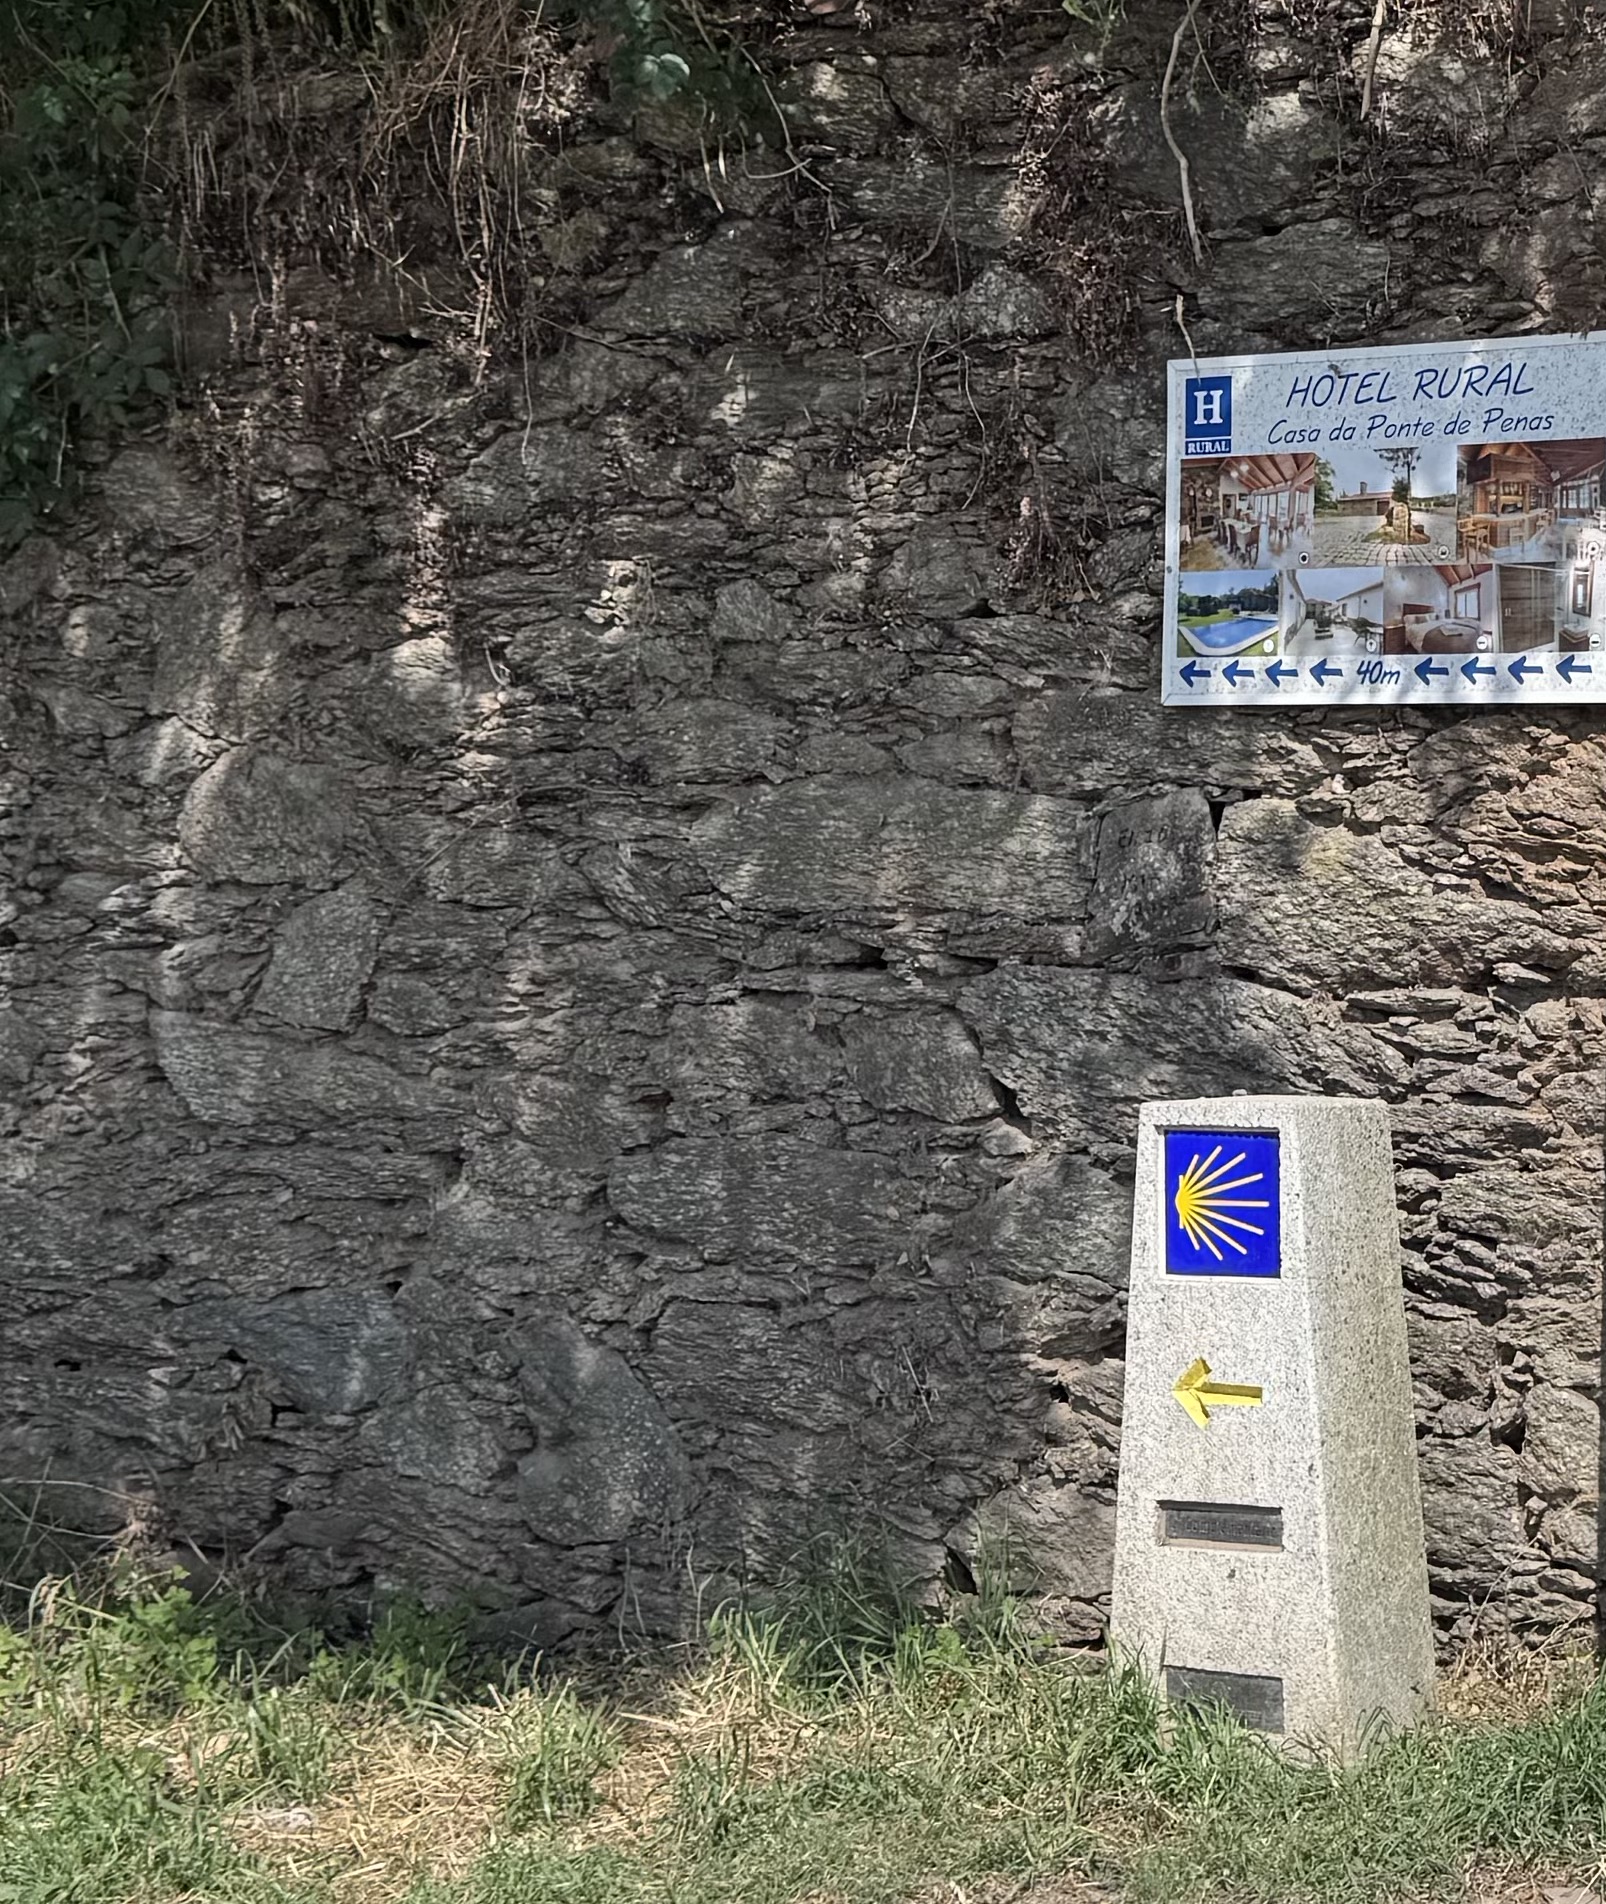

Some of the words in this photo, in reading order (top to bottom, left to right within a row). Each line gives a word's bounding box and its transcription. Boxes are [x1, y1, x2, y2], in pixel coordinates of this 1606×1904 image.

[1286, 371, 1398, 408] HOTEL
[1412, 362, 1535, 401] RURAL
[1193, 389, 1224, 425] H
[1268, 418, 1321, 445] Casa
[1328, 417, 1356, 441] da
[1366, 414, 1435, 439] Ponte
[1443, 410, 1471, 435] de
[1482, 407, 1556, 433] Penas
[1187, 440, 1230, 454] RURAL
[1356, 659, 1401, 685] 40m
